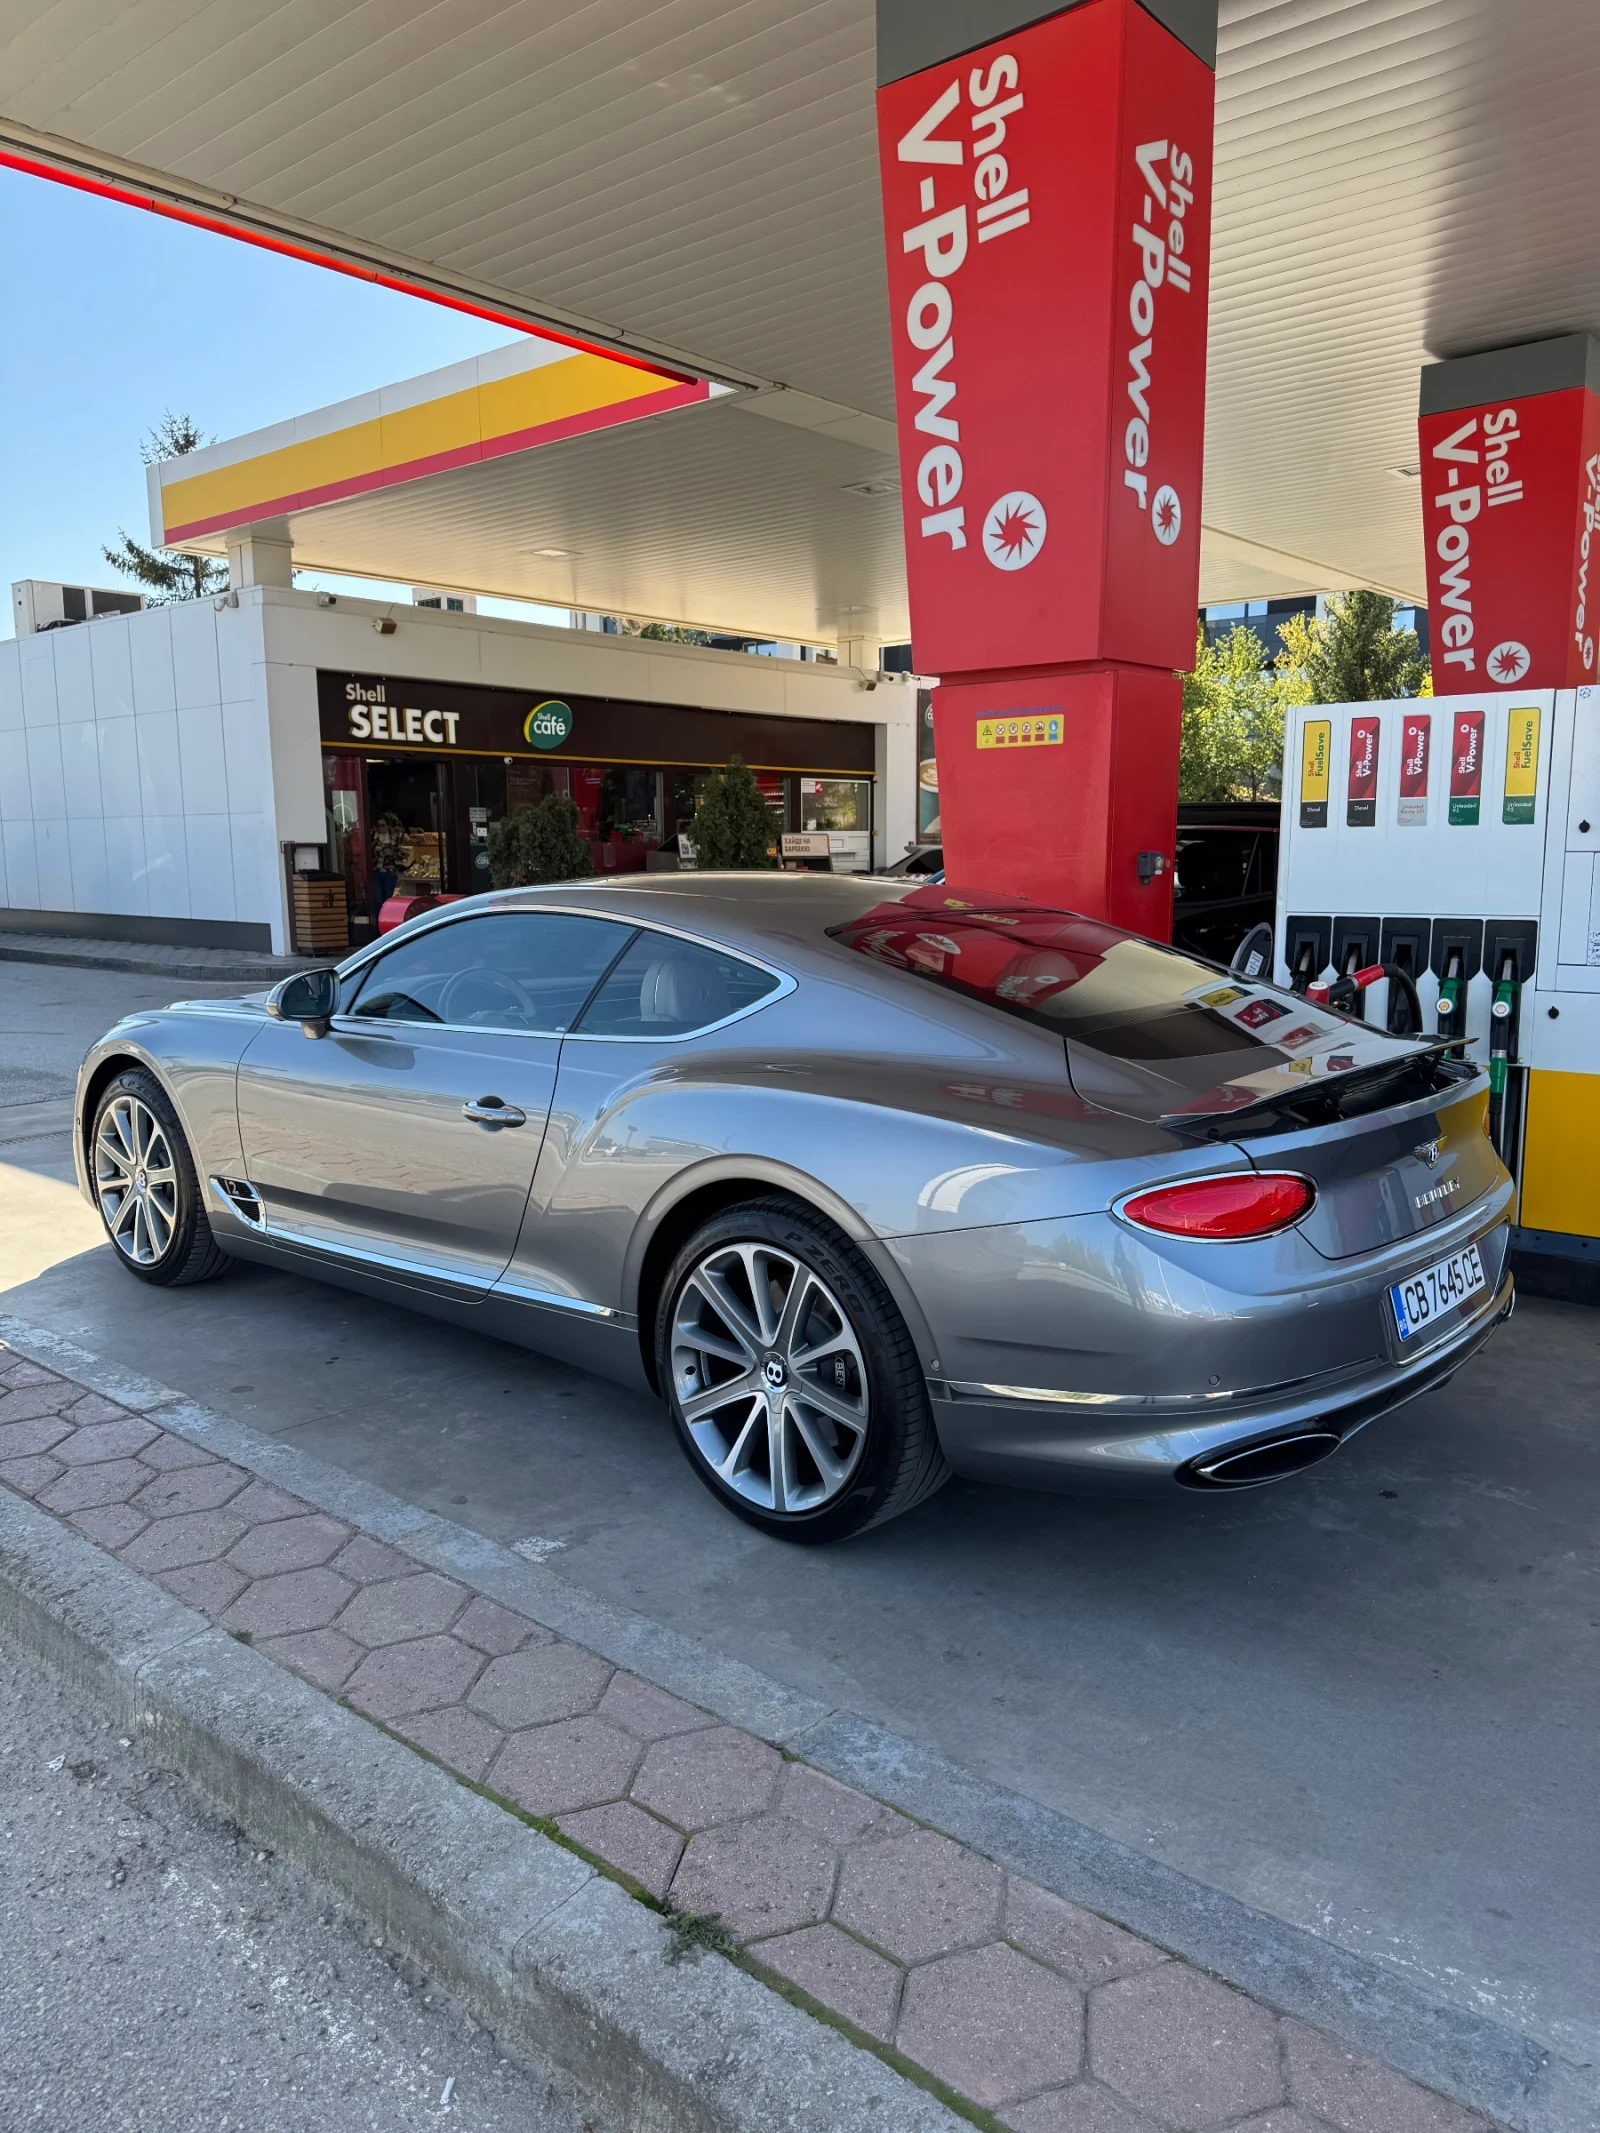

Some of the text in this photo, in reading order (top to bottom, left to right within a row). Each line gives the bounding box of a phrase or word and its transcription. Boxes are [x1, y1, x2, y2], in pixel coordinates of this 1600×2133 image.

[968, 54, 1030, 243] Shell
[1166, 144, 1194, 294] Shell
[897, 79, 968, 551] V-Power
[1123, 139, 1169, 511] V-Power
[1483, 408, 1523, 507] Shell
[1432, 418, 1481, 673] V-Power
[1574, 453, 1598, 653] V-Power
[345, 683, 386, 703] Shell
[350, 704, 460, 745] SELECT
[533, 716, 566, 736] café
[537, 712, 551, 721] Shell
[1315, 732, 1325, 777] FuelSave
[1362, 733, 1373, 777] V-Power
[1413, 730, 1425, 775] V-Power
[1458, 757, 1466, 774] Shell
[1466, 727, 1477, 773] V-Power
[1521, 720, 1533, 769] FuelSave
[1355, 761, 1363, 778] Shell
[223, 1179, 240, 1195] 12
[803, 1244, 866, 1313] ZERO
[1404, 1247, 1483, 1324] CB 7645 CE
[835, 1362, 843, 1386] BEN
